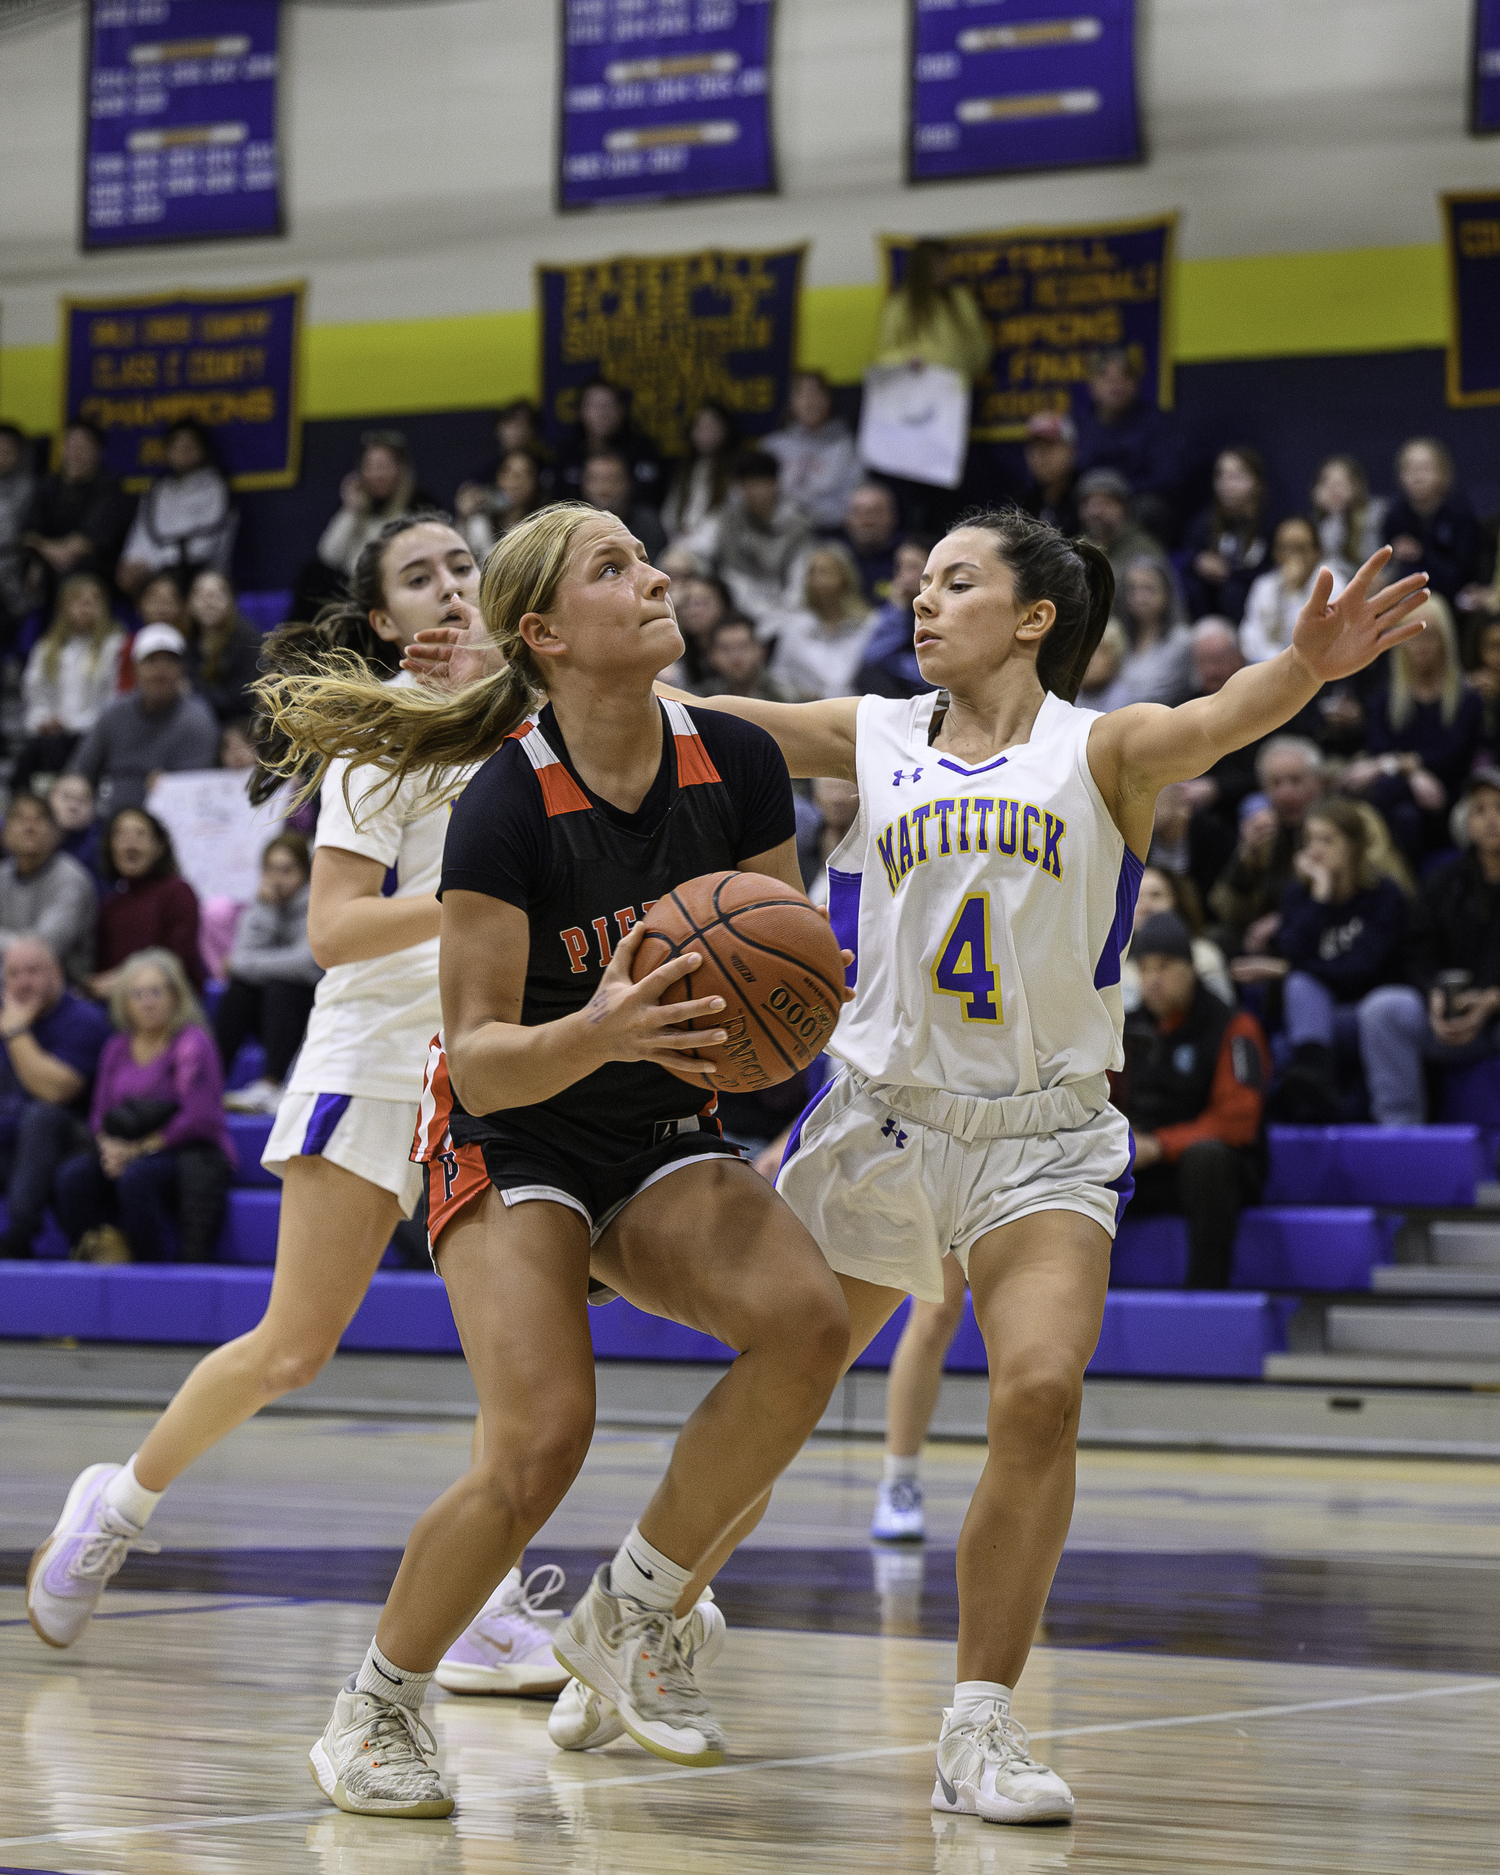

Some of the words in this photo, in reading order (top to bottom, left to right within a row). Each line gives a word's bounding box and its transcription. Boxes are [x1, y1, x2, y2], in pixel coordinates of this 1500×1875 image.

[876, 797, 1067, 898] MATTITUCK
[930, 891, 1004, 1025] 4
[437, 1150, 460, 1203] P
